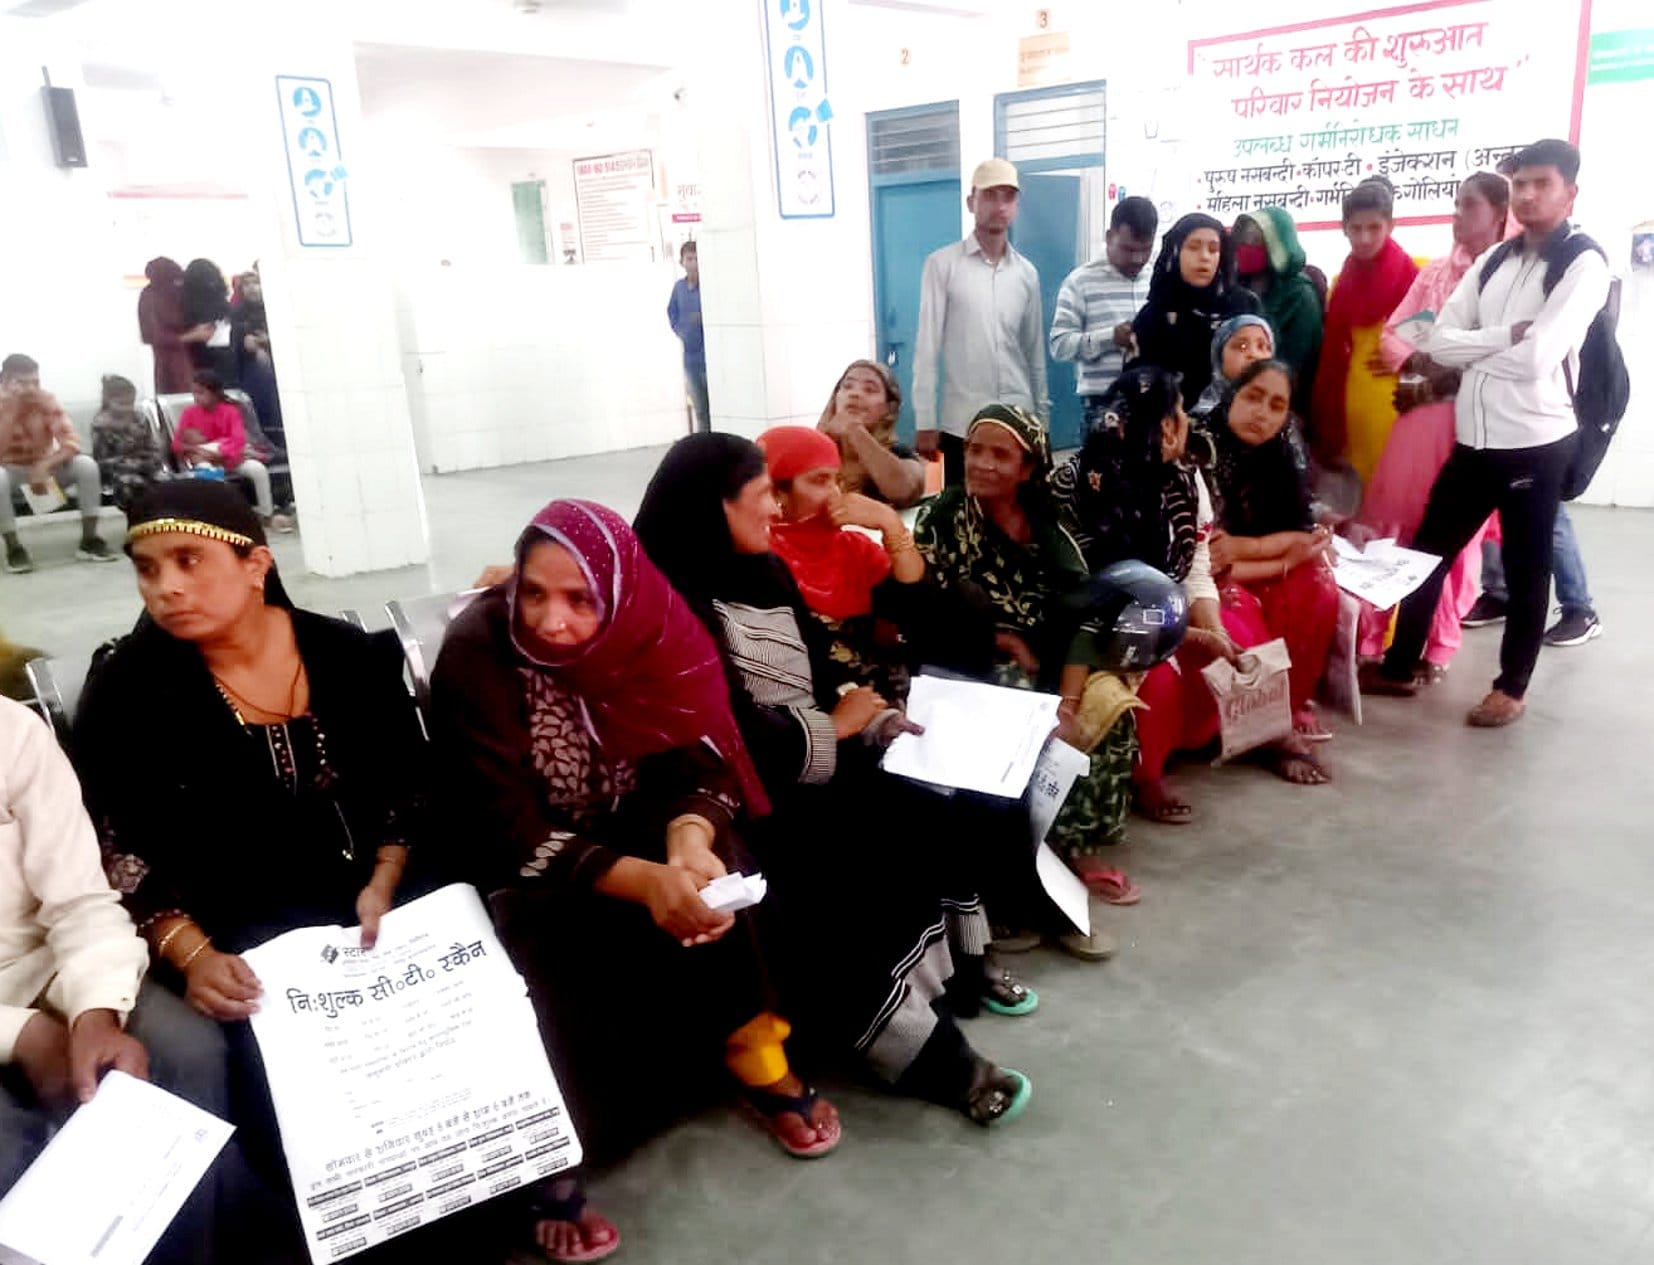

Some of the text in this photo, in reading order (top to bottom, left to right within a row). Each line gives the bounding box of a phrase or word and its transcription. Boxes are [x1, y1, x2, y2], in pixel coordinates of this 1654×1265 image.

[1039, 10, 1048, 29] 3
[901, 47, 909, 65] 2
[1289, 43, 1337, 70] कल
[1343, 26, 1380, 63] की
[1231, 86, 1304, 118] परिवार
[1309, 77, 1399, 111] नियोजन
[1408, 67, 1434, 99] के
[1407, 118, 1459, 142] साधन
[1377, 148, 1457, 175] इंजेक्शन
[1206, 190, 1252, 212] महिला
[437, 940, 487, 972] स्कैन
